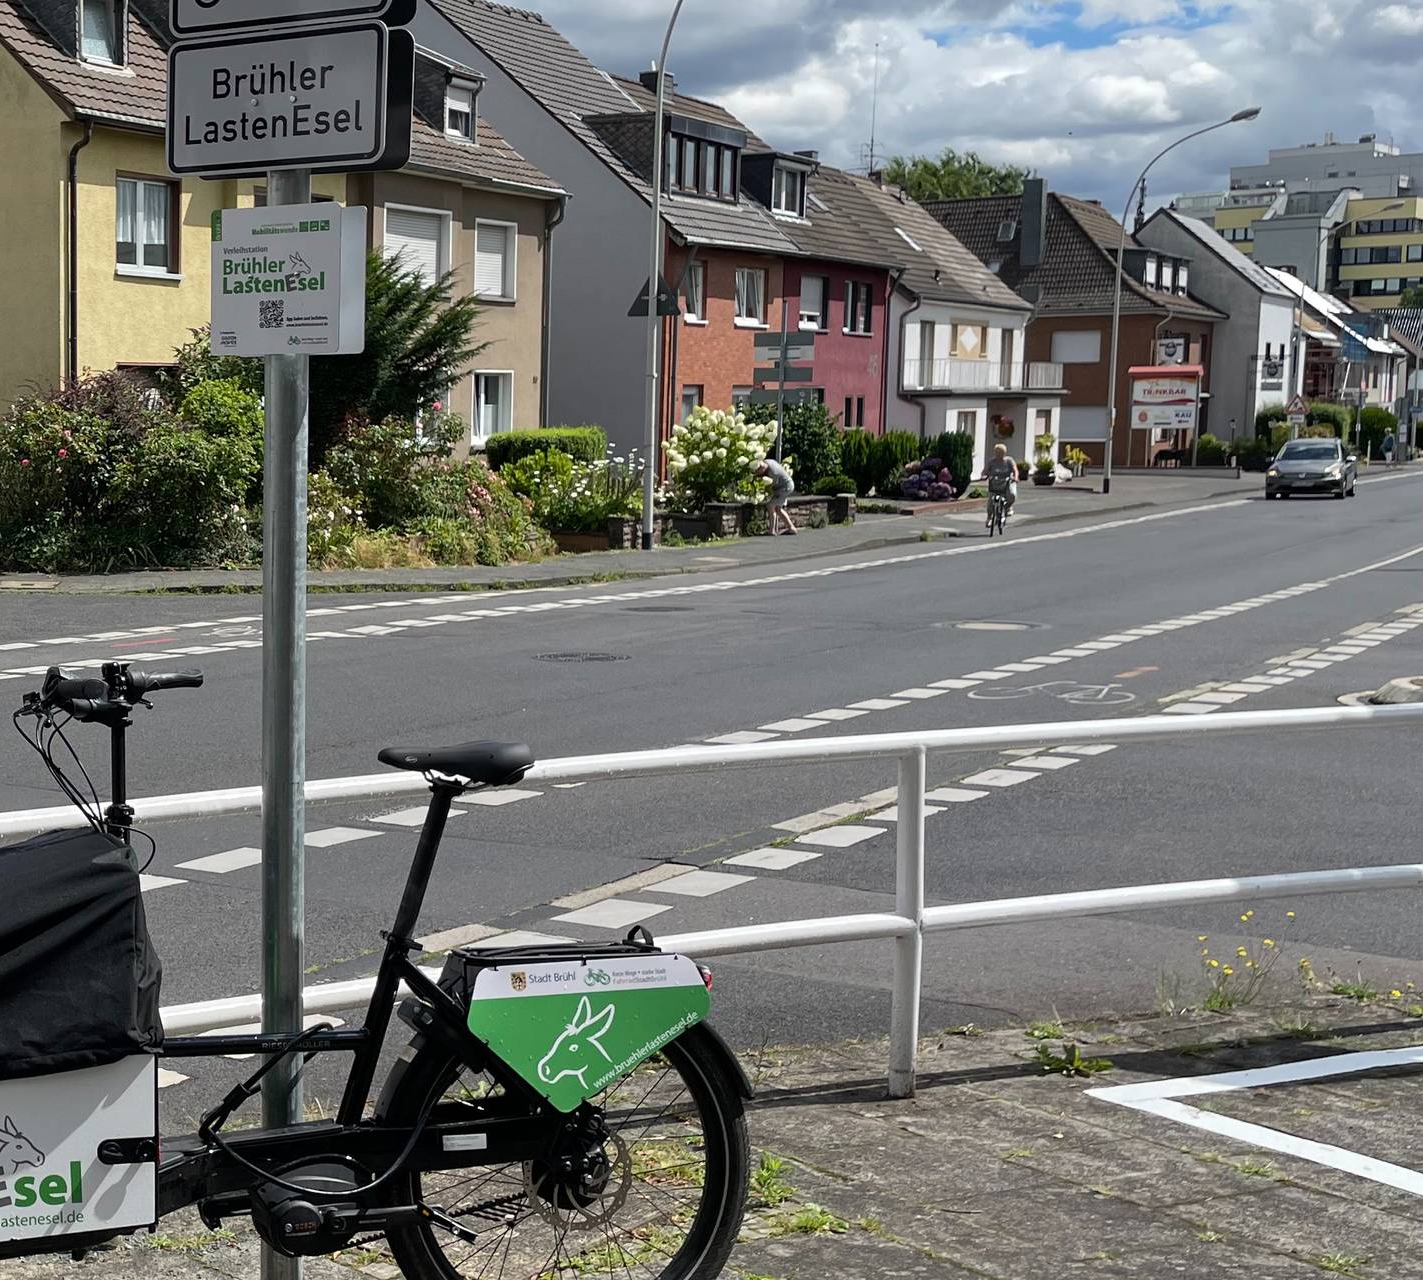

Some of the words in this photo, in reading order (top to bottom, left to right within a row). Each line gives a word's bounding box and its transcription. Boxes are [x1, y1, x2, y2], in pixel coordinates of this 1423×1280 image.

[212, 61, 334, 99] Brühler
[184, 100, 363, 146] LastenEsel
[223, 245, 268, 255] Verleihstation
[223, 256, 286, 276] Brühler
[223, 271, 325, 295] LastenEsel
[529, 973, 552, 984] Stadt
[553, 971, 576, 983] Brühl
[592, 1010, 699, 1090] www.bruehlerlastenesel.de
